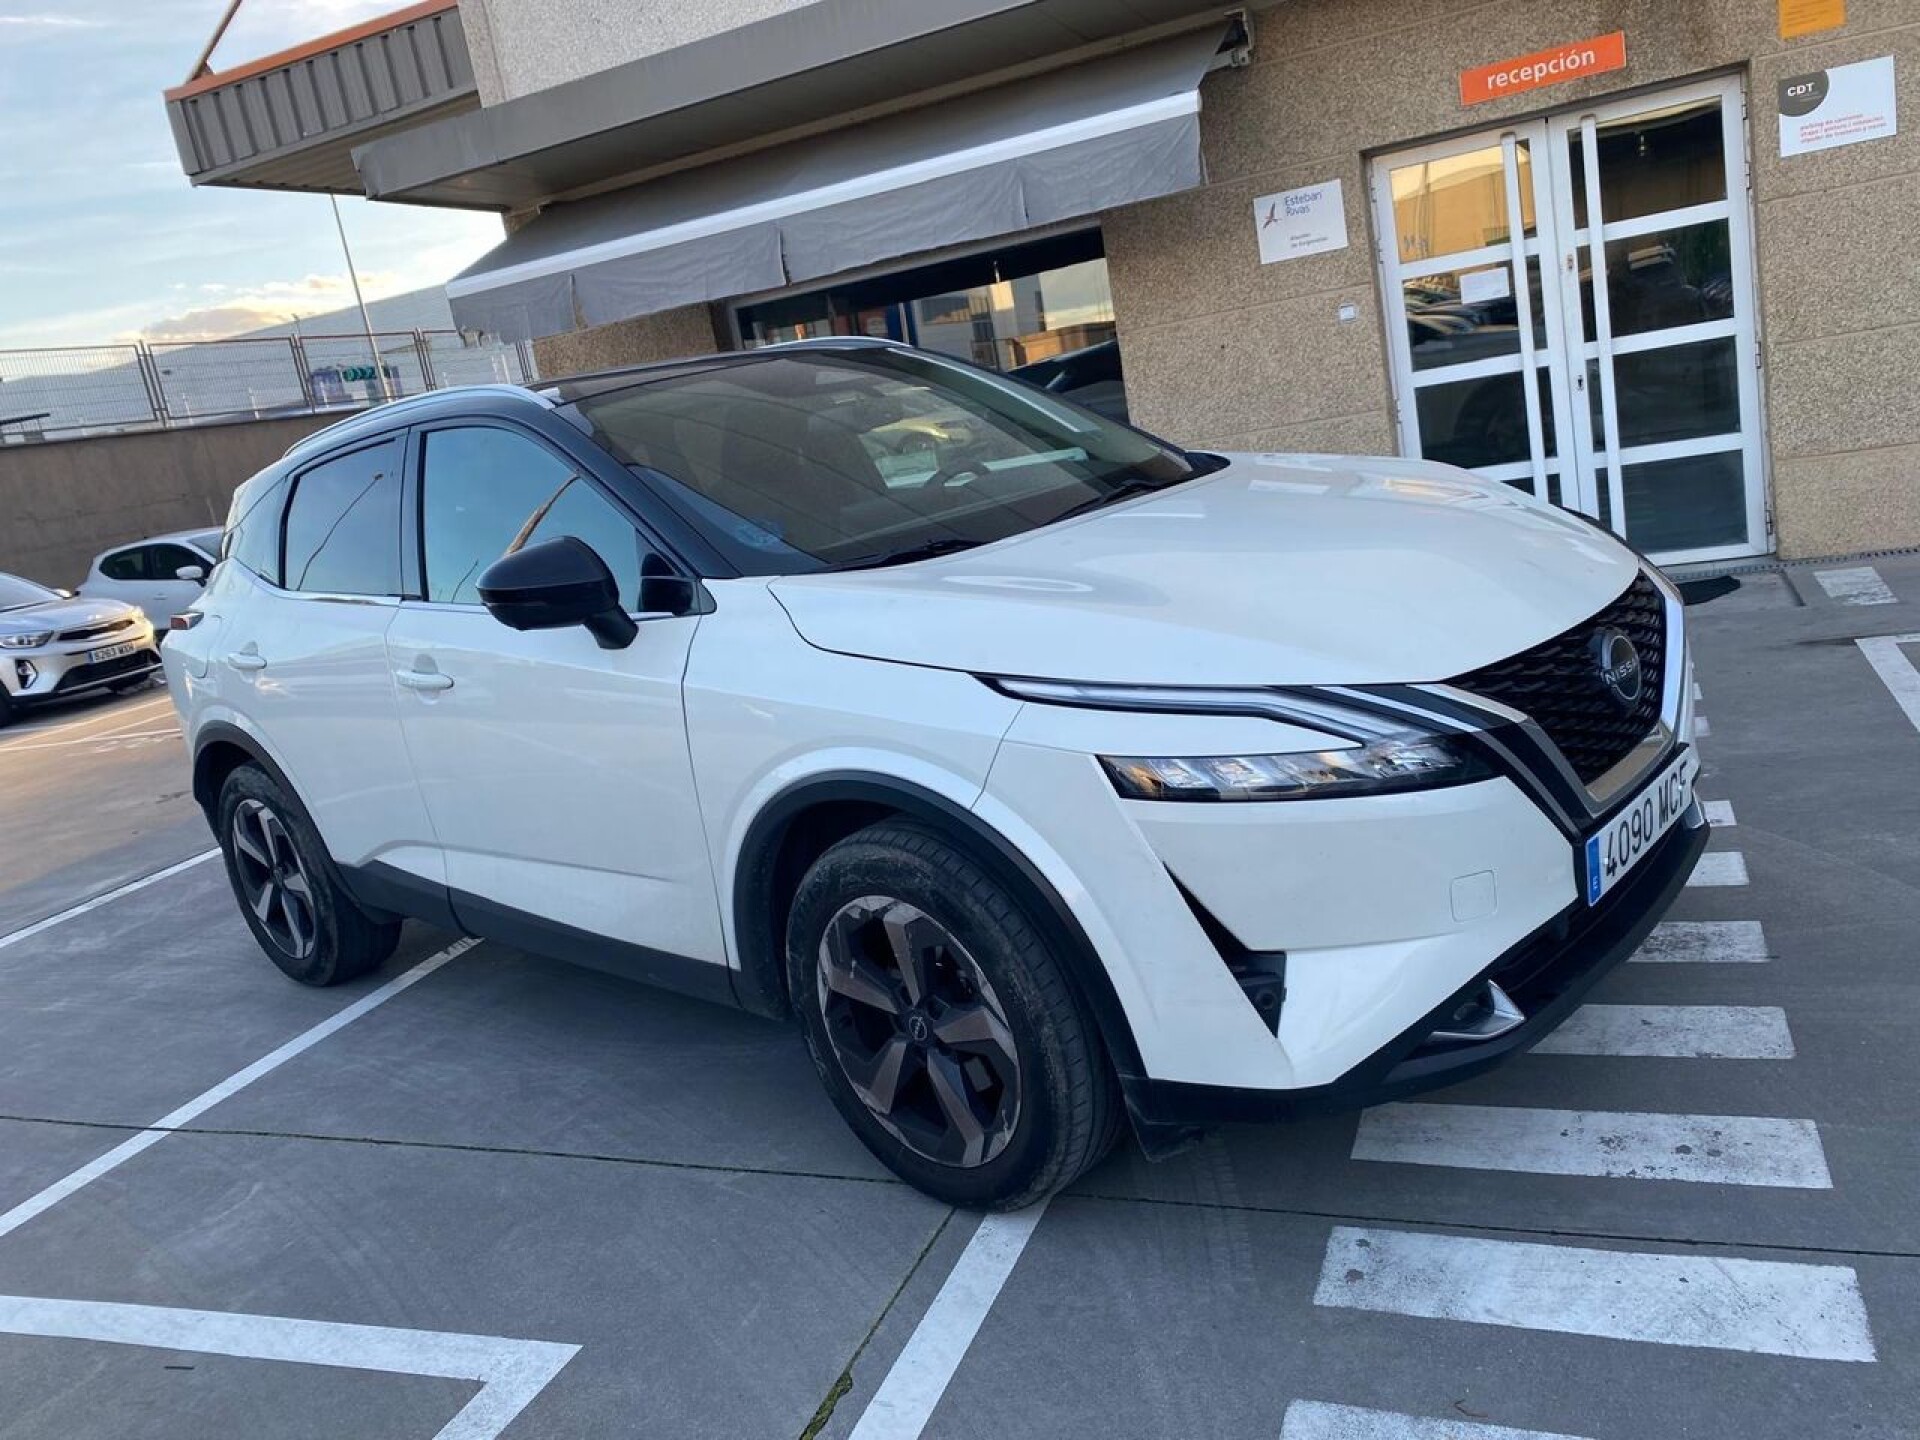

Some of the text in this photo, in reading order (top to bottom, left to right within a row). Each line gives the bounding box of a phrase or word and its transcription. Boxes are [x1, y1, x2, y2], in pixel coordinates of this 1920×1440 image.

[1487, 49, 1596, 91] recepción
[1787, 82, 1815, 97] CDT
[1284, 191, 1322, 206] Esteban
[1605, 759, 1688, 877] 4090 MCF
